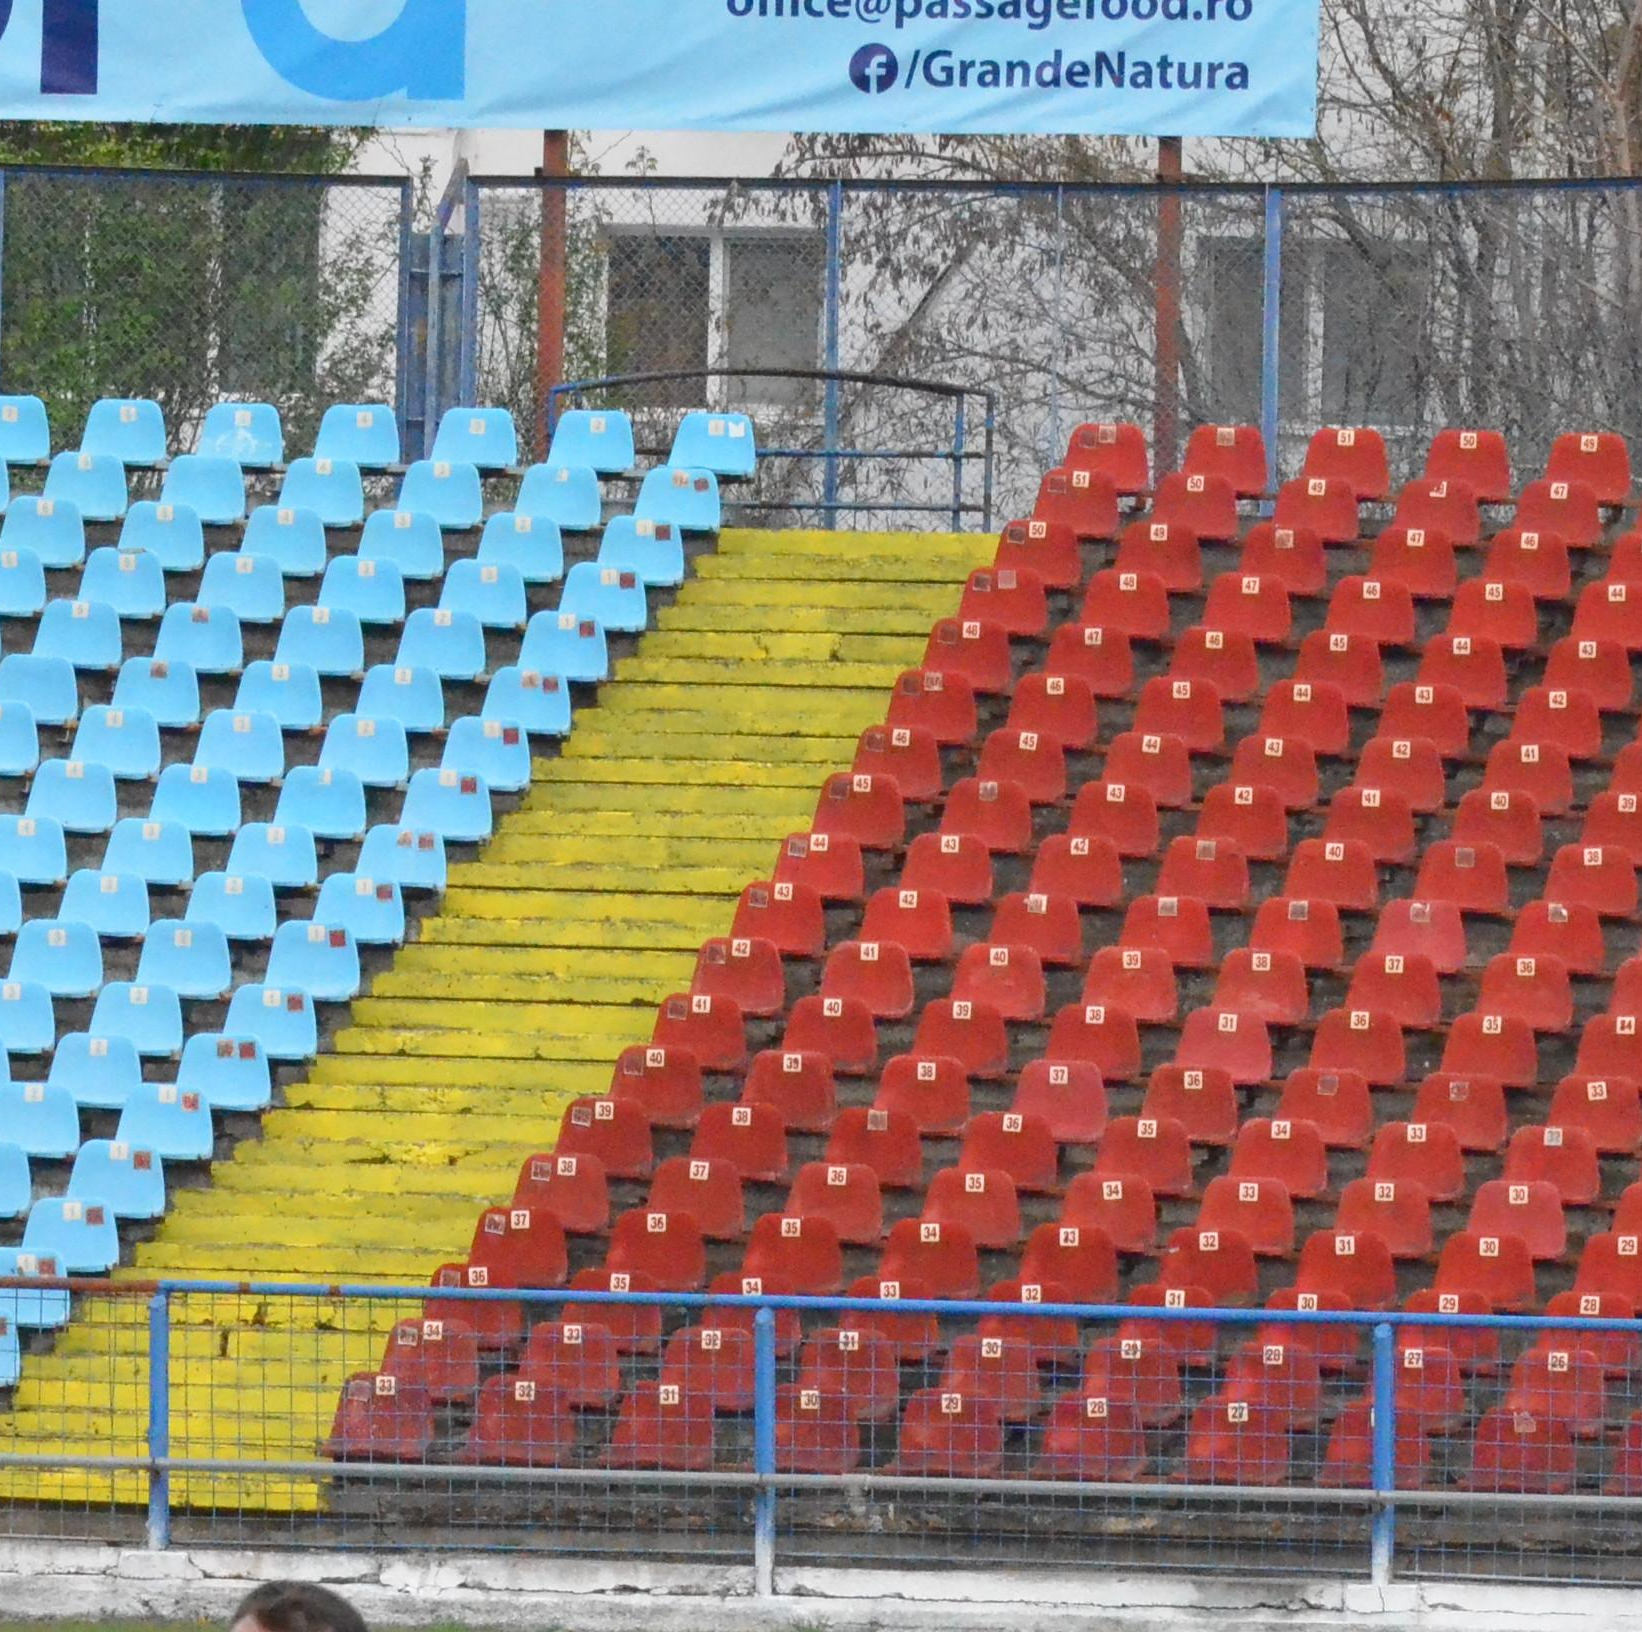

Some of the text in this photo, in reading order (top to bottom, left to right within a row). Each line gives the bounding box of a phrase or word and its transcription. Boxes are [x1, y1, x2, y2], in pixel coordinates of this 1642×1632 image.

[905, 48, 1249, 90] /GrandeNatura
[1153, 526, 1165, 539] 49
[1244, 579, 1257, 592] 47
[1208, 634, 1221, 646] 46
[1455, 640, 1469, 652] 44
[1175, 684, 1189, 697] 45
[1551, 694, 1565, 706] 42
[895, 732, 907, 744] 46
[1145, 738, 1158, 751] 44
[1395, 743, 1409, 756] 42
[855, 777, 869, 790] 45
[1237, 790, 1251, 802] 42
[1493, 795, 1507, 808] 40
[813, 837, 826, 849] 44
[1073, 839, 1086, 853] 42
[1587, 850, 1599, 864] 38
[901, 893, 915, 906] 42
[734, 942, 748, 955] 42
[992, 950, 1007, 964] 40
[1255, 956, 1268, 969] 38
[1519, 960, 1533, 974] 36
[695, 998, 707, 1011] 41
[956, 1004, 970, 1017] 39
[1353, 1014, 1367, 1027] 36
[1485, 1017, 1499, 1032] 35
[786, 1057, 800, 1070] 39
[1052, 1068, 1065, 1082] 37
[1591, 1084, 1605, 1098] 33
[735, 1110, 749, 1124] 38
[1140, 1122, 1155, 1136] 35
[560, 1160, 574, 1174] 38
[830, 1169, 845, 1184] 36
[1106, 1184, 1120, 1198] 34
[1378, 1185, 1392, 1199] 32
[650, 1216, 665, 1230] 36
[923, 1226, 938, 1240] 34
[1339, 1239, 1351, 1253] 31
[1483, 1240, 1497, 1254] 30
